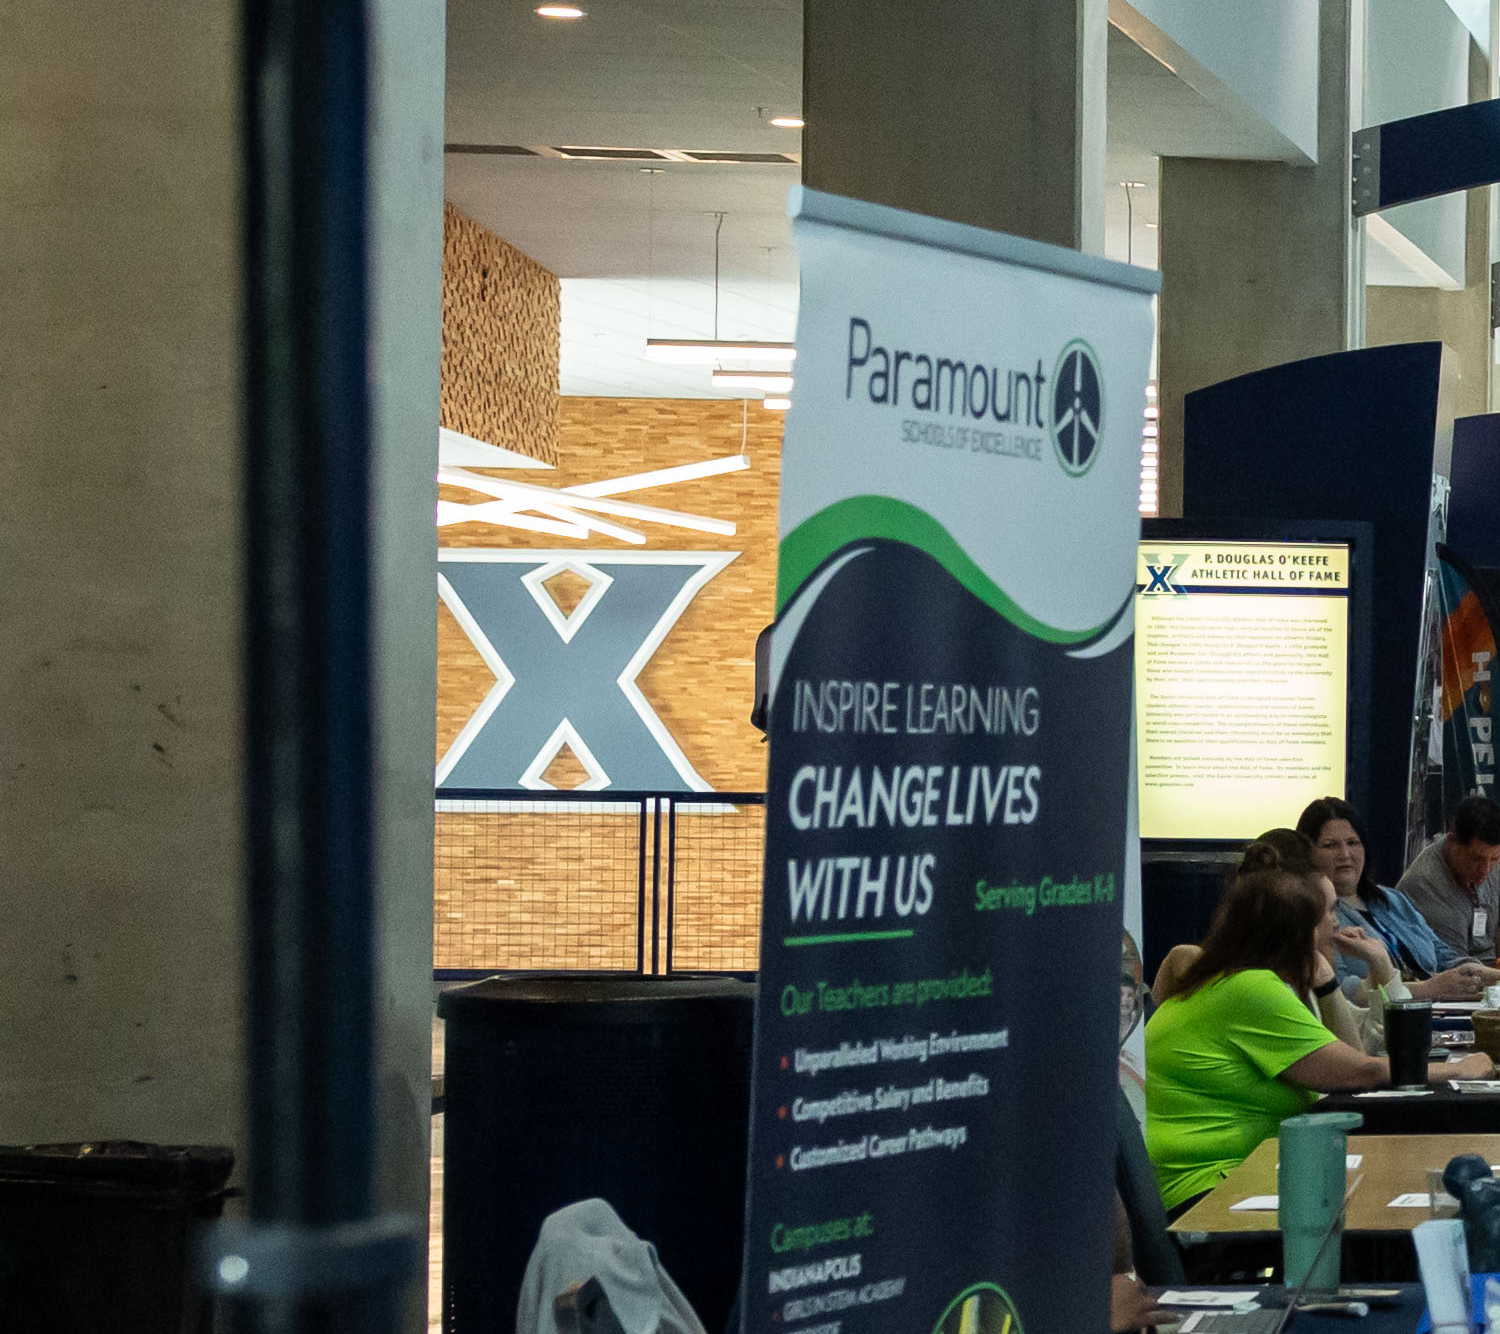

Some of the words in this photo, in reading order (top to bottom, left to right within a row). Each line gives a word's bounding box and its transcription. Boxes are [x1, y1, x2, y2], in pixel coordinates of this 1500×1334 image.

[846, 315, 1046, 429] Paramount
[1191, 568, 1249, 581] ATHLETIC
[1253, 569, 1286, 581] HALL
[1289, 570, 1305, 581] OF
[1308, 570, 1341, 582] FAME
[1204, 554, 1213, 565] P.
[1217, 554, 1275, 566] DOUGLAS
[1279, 554, 1330, 566] O'KEEFE
[793, 680, 900, 734] INSPIRE
[906, 683, 1040, 736] LEARNING
[788, 764, 944, 830] CHANGE
[945, 765, 1041, 826] LIVES
[788, 856, 888, 922] WITH
[895, 853, 936, 917] US
[974, 878, 1036, 915] Serving
[1038, 873, 1094, 905] Grades
[781, 984, 814, 1016] Our
[817, 979, 890, 1012] Teachers
